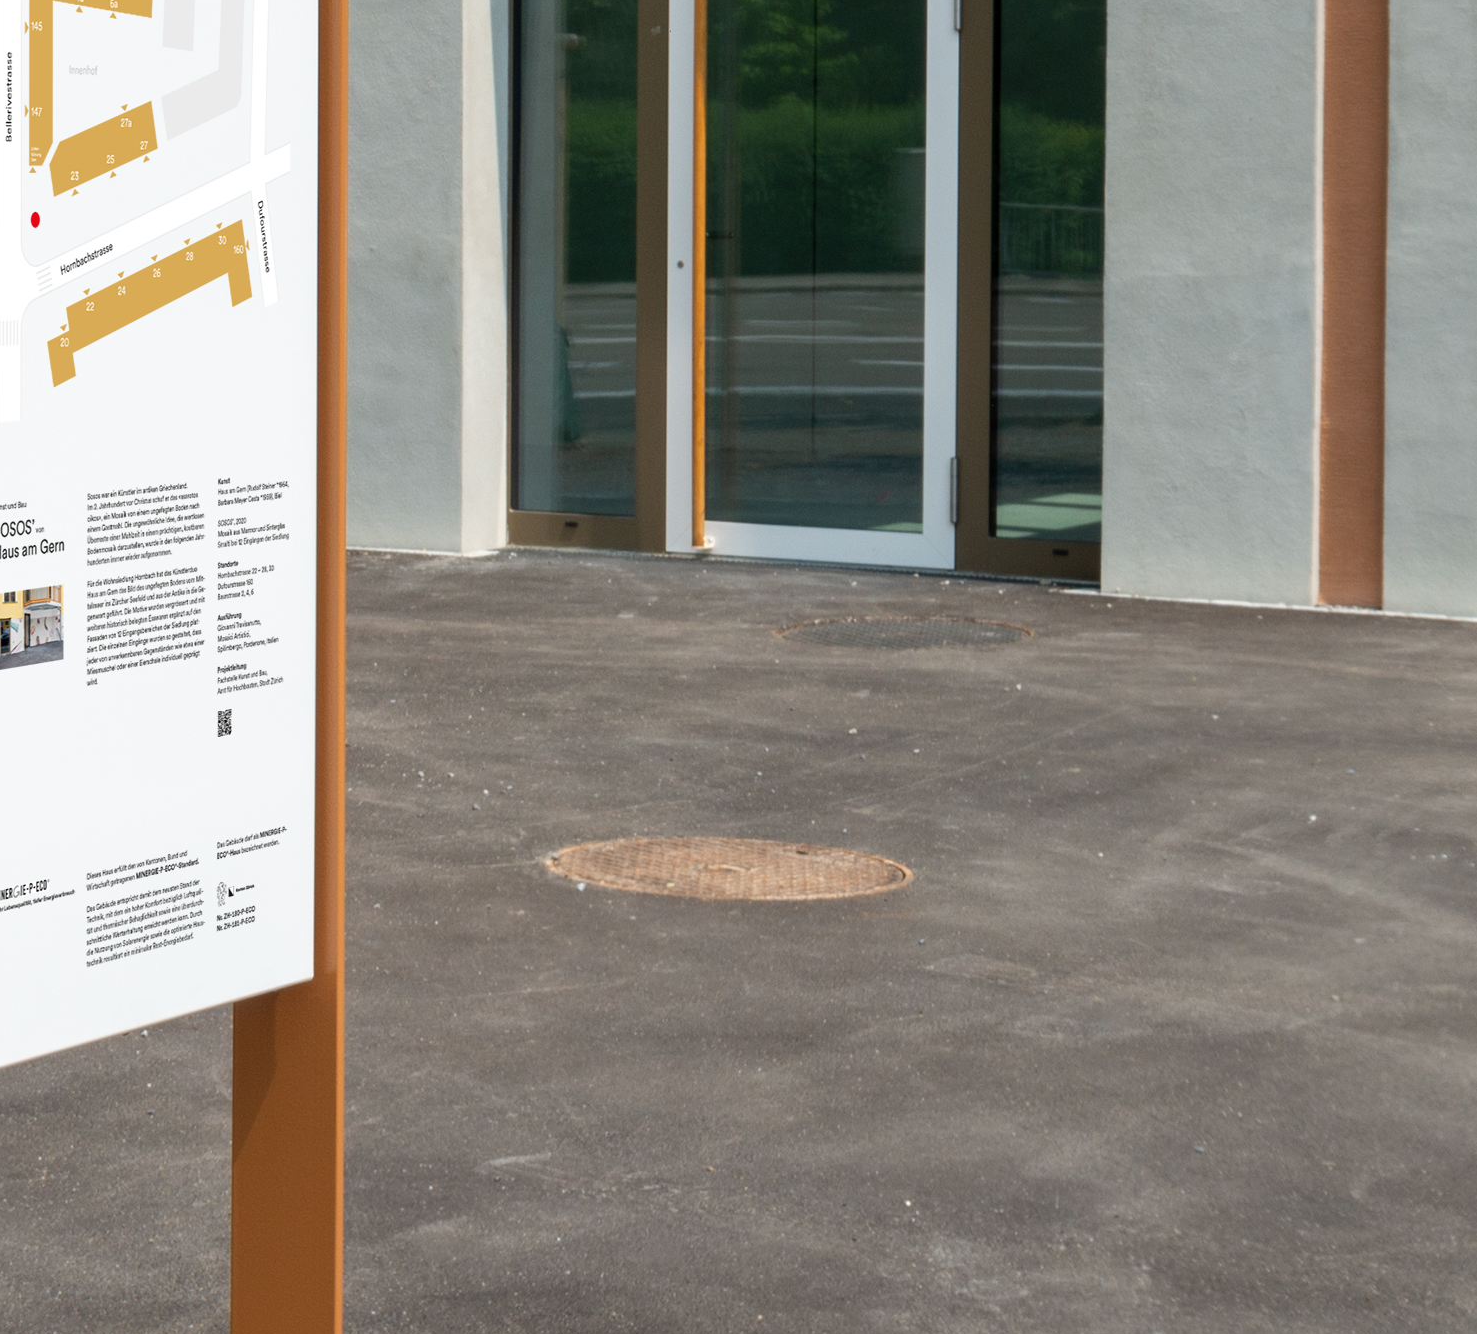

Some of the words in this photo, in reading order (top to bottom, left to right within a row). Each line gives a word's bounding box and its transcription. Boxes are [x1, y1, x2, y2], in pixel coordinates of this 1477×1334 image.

[110, 0, 119, 8] 6a
[31, 22, 42, 31] 145
[68, 65, 99, 75] Innenhof
[31, 107, 42, 116] 147
[121, 118, 132, 127] 27a
[140, 141, 148, 150] 27
[107, 155, 114, 164] 25
[71, 171, 79, 180] 23
[219, 236, 226, 244] 30
[258, 200, 270, 273] Dufourstrasse
[233, 245, 244, 254] 160
[60, 244, 113, 275] Hornbachstrasse
[186, 252, 193, 261] 28
[153, 268, 161, 277] 26
[118, 286, 126, 295] 24
[86, 302, 94, 311] 22
[60, 337, 70, 347] 20
[18, 501, 27, 509] Bau
[22, 544, 37, 557] am
[40, 538, 65, 554] Gern
